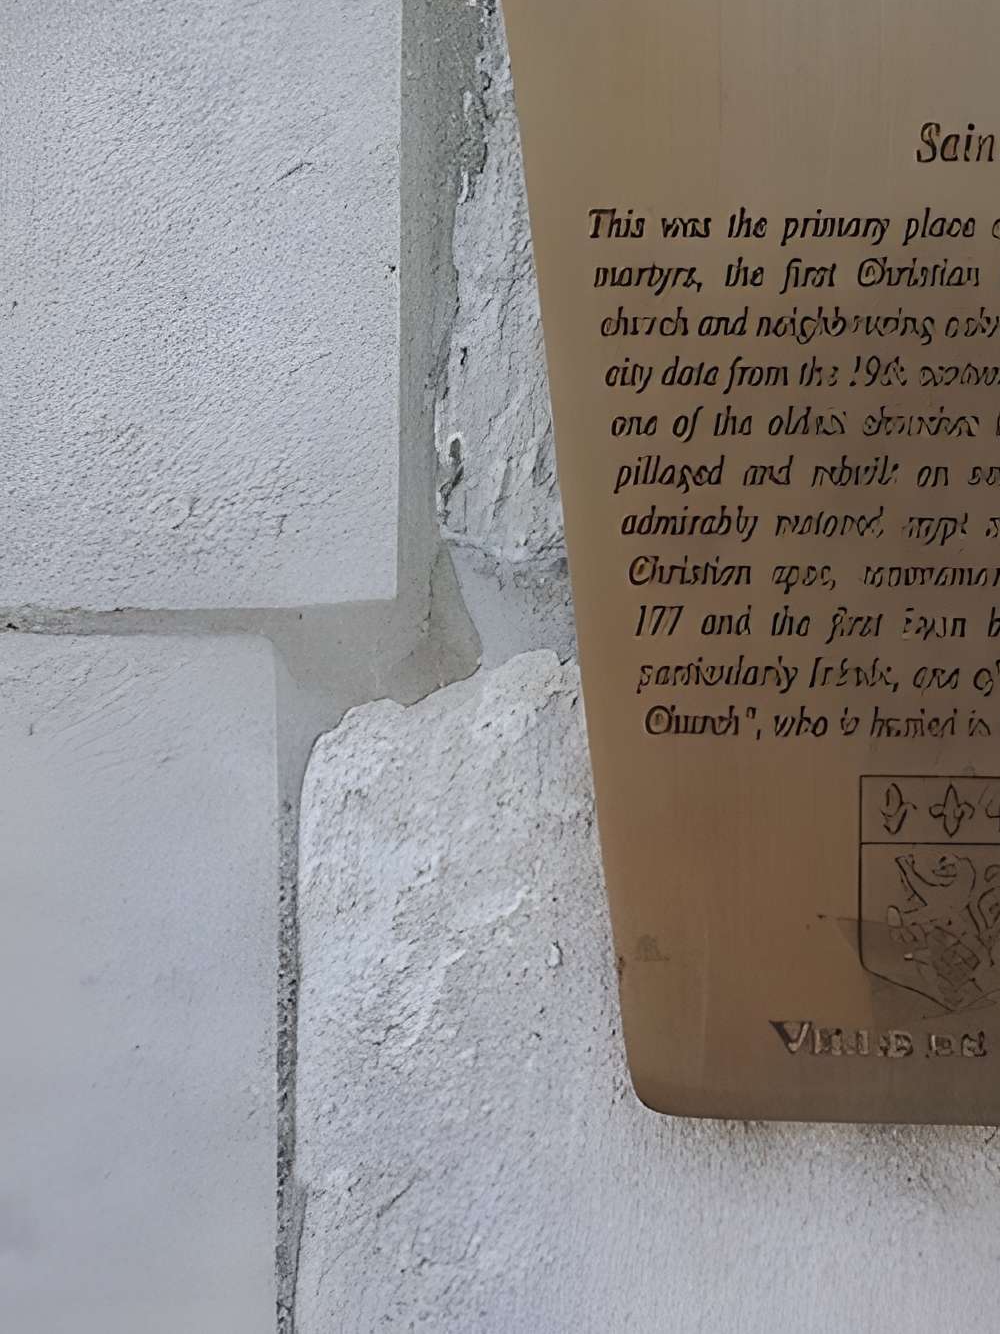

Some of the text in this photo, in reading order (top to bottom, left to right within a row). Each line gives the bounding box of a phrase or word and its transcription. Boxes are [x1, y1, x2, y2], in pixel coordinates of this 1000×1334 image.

[587, 206, 646, 239] This
[726, 205, 768, 239] the
[779, 207, 891, 247] primary
[900, 205, 976, 247] place
[723, 254, 765, 288] the
[777, 256, 837, 296] first
[856, 255, 980, 288] Christian
[696, 304, 749, 337] and
[603, 355, 654, 395] city
[659, 354, 719, 387] date
[720, 354, 789, 395] from
[609, 413, 659, 438] one
[671, 404, 705, 444] of
[711, 403, 753, 437] the
[612, 452, 726, 495] pillaged
[915, 464, 949, 488] on
[619, 503, 759, 543] admirably
[627, 553, 752, 587] Christian
[634, 603, 685, 637] 177
[699, 603, 752, 637] and
[769, 603, 811, 637] the
[772, 704, 829, 738] who
